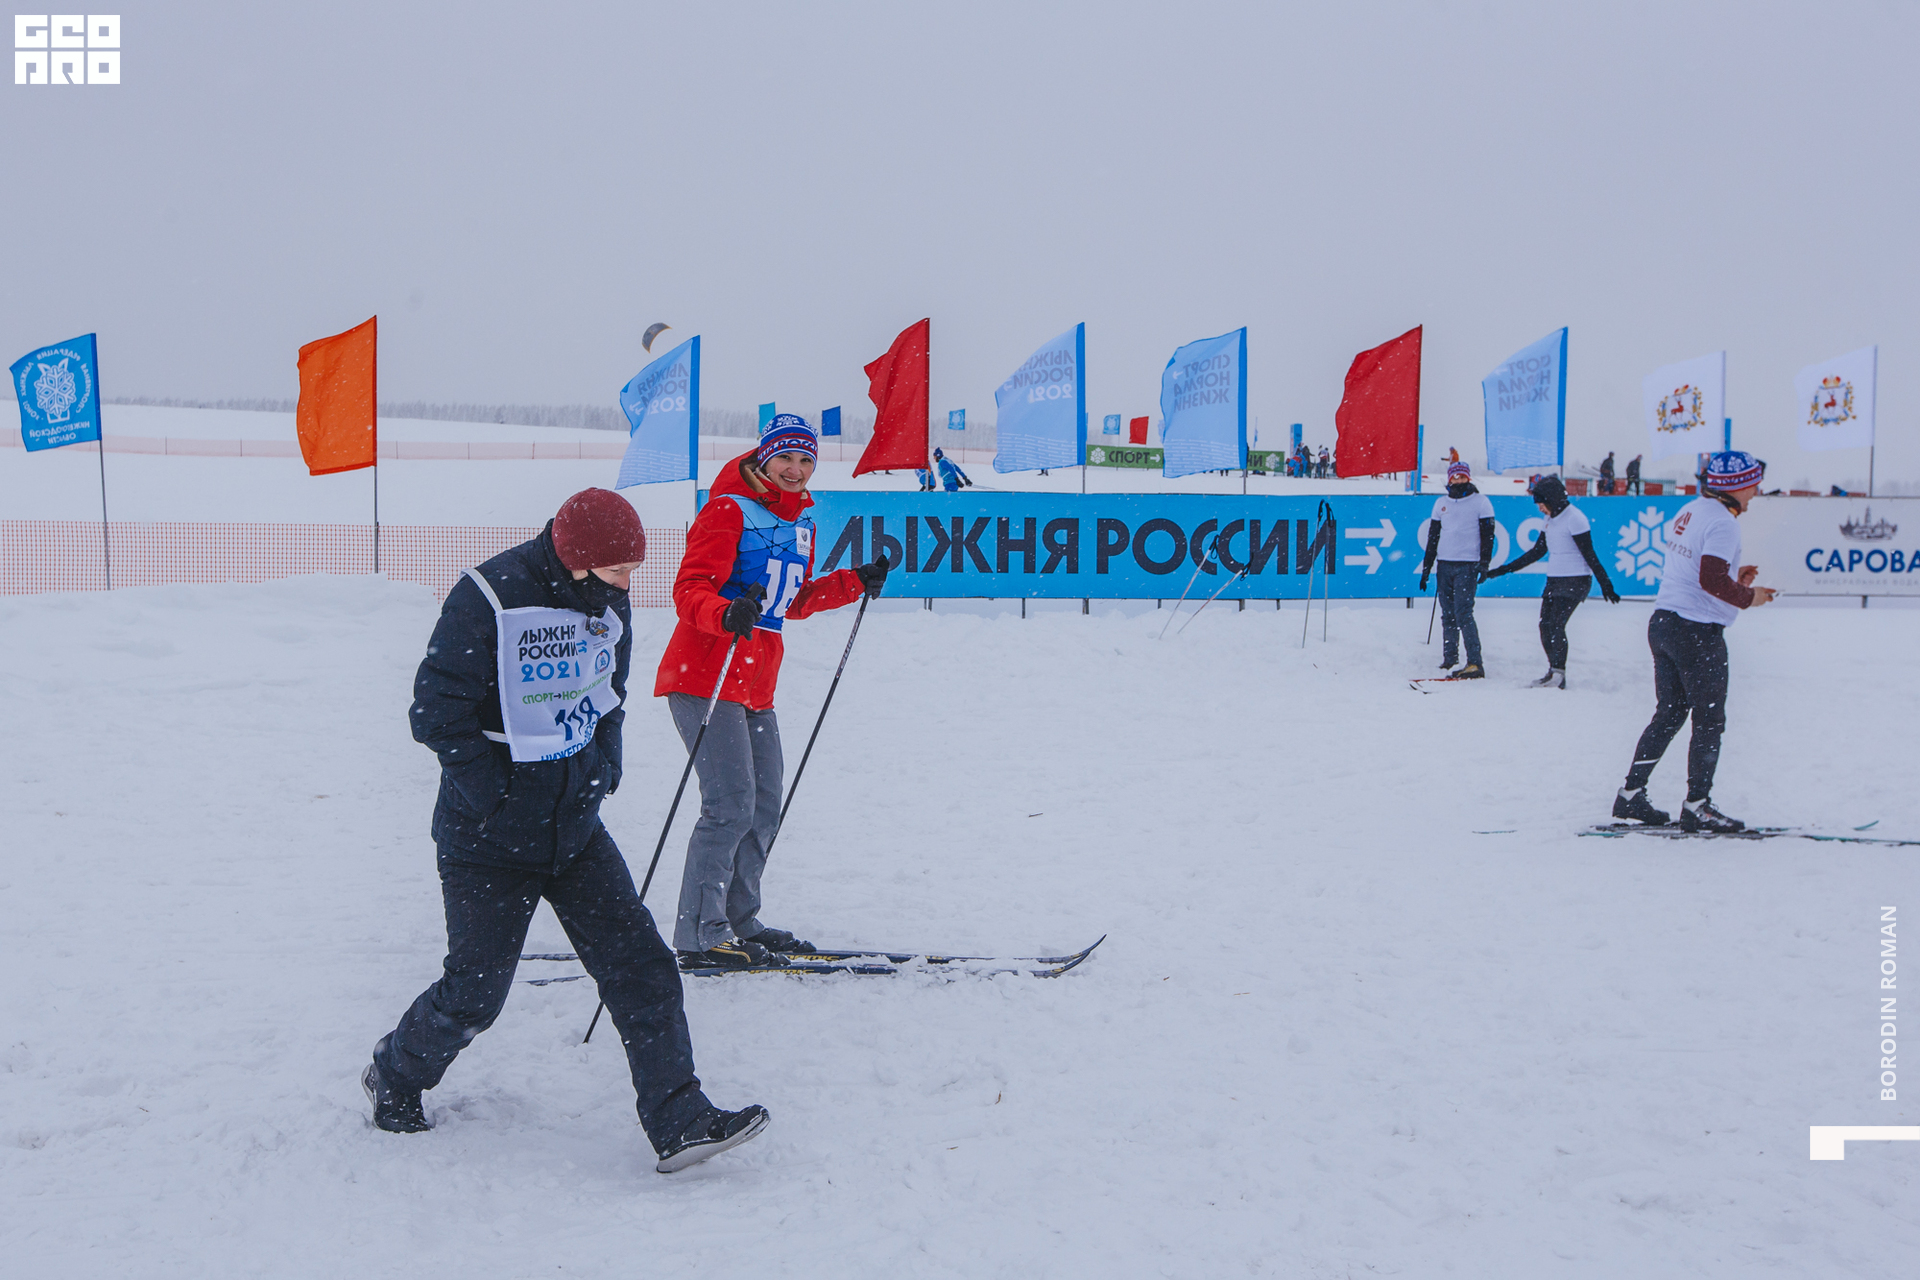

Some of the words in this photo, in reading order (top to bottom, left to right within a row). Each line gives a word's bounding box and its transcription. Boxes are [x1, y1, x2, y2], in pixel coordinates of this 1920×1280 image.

[1109, 450, 1149, 464] СПОРТ
[819, 516, 1079, 574] ЛЫЖНЯ
[1096, 518, 1336, 575] РОССИИ
[517, 625, 576, 646] ЛЫЖНЯ
[519, 641, 579, 661] РОССИИ
[521, 660, 580, 682] 2021
[522, 692, 554, 704] СПОРТ
